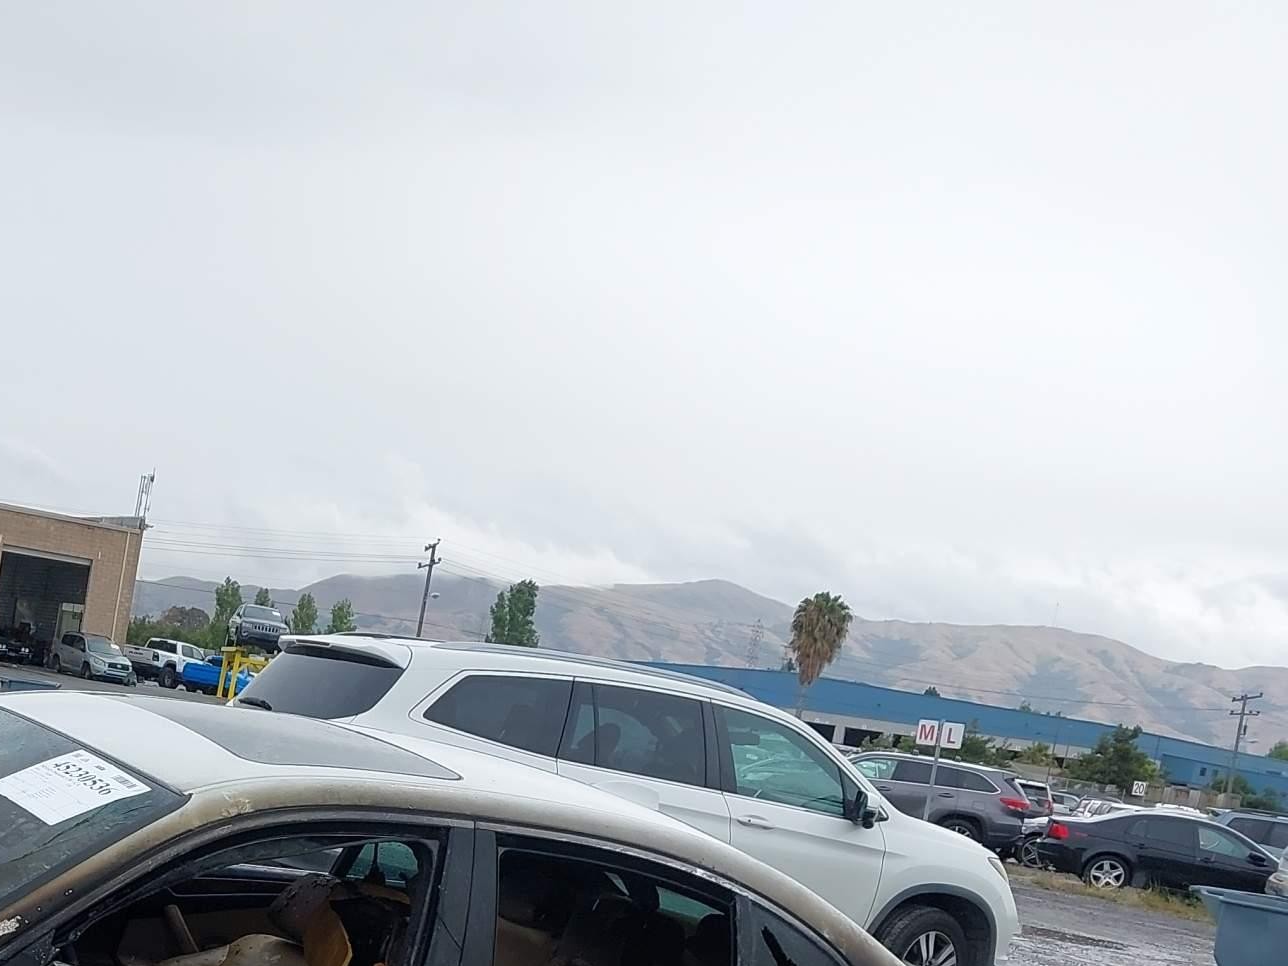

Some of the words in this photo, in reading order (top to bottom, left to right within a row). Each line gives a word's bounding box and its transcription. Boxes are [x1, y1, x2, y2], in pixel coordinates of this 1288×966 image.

[918, 724, 936, 741] M
[946, 727, 956, 744] L
[53, 761, 112, 796] 45230536
[1134, 782, 1145, 794] 20
